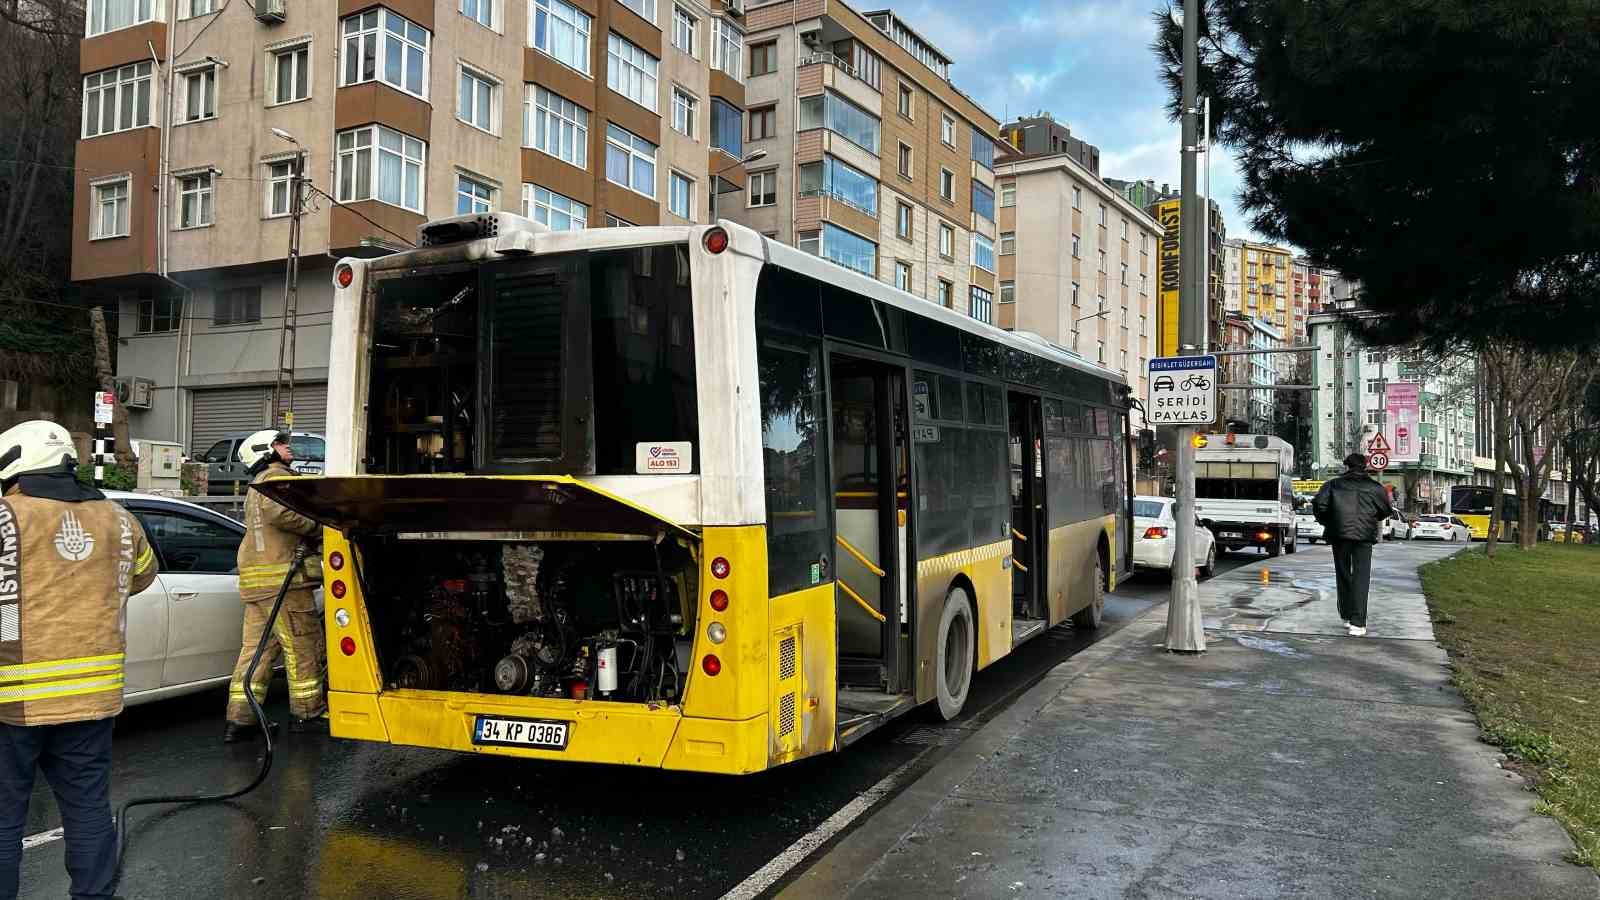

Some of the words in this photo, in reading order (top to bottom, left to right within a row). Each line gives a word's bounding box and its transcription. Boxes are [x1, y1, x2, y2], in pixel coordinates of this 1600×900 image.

[1157, 394, 1206, 408] ŞERİDİ
[1154, 411, 1208, 421] PAYLAŞ
[1372, 456, 1385, 466] 30
[483, 721, 501, 739] 34
[506, 723, 523, 741] KP
[528, 725, 562, 744] 0386
